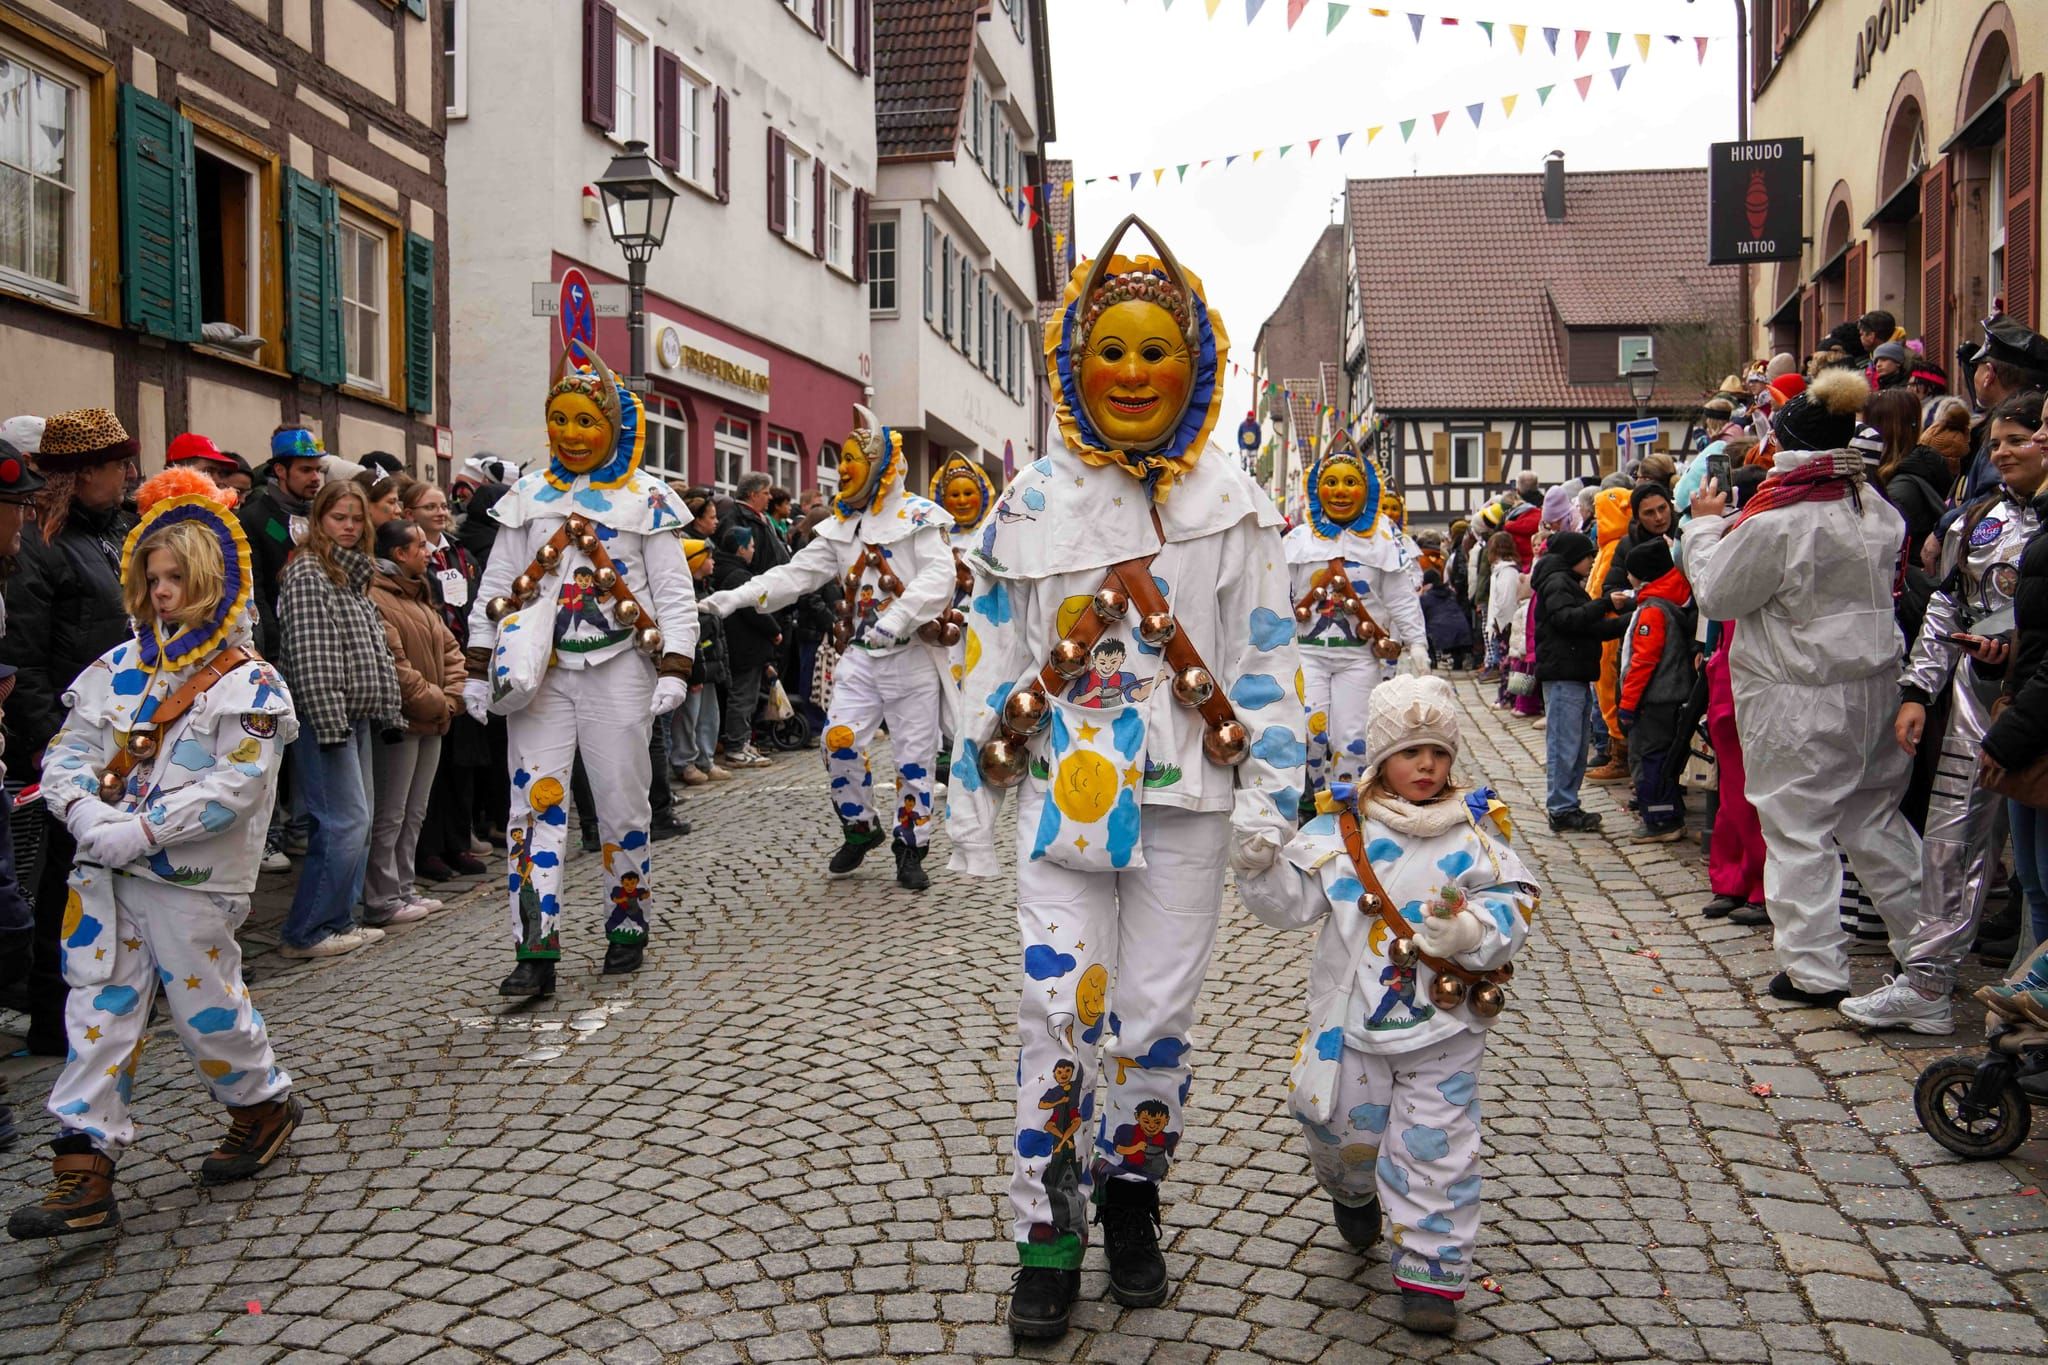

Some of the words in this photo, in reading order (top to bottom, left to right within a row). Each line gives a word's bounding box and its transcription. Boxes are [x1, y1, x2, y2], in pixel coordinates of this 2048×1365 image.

[1731, 143, 1783, 162] HIRUDO
[1737, 240, 1776, 254] TATTOO
[858, 352, 871, 379] 10
[1379, 431, 1390, 478] PHOTO
[425, 463, 435, 482] 12
[444, 570, 458, 581] 26
